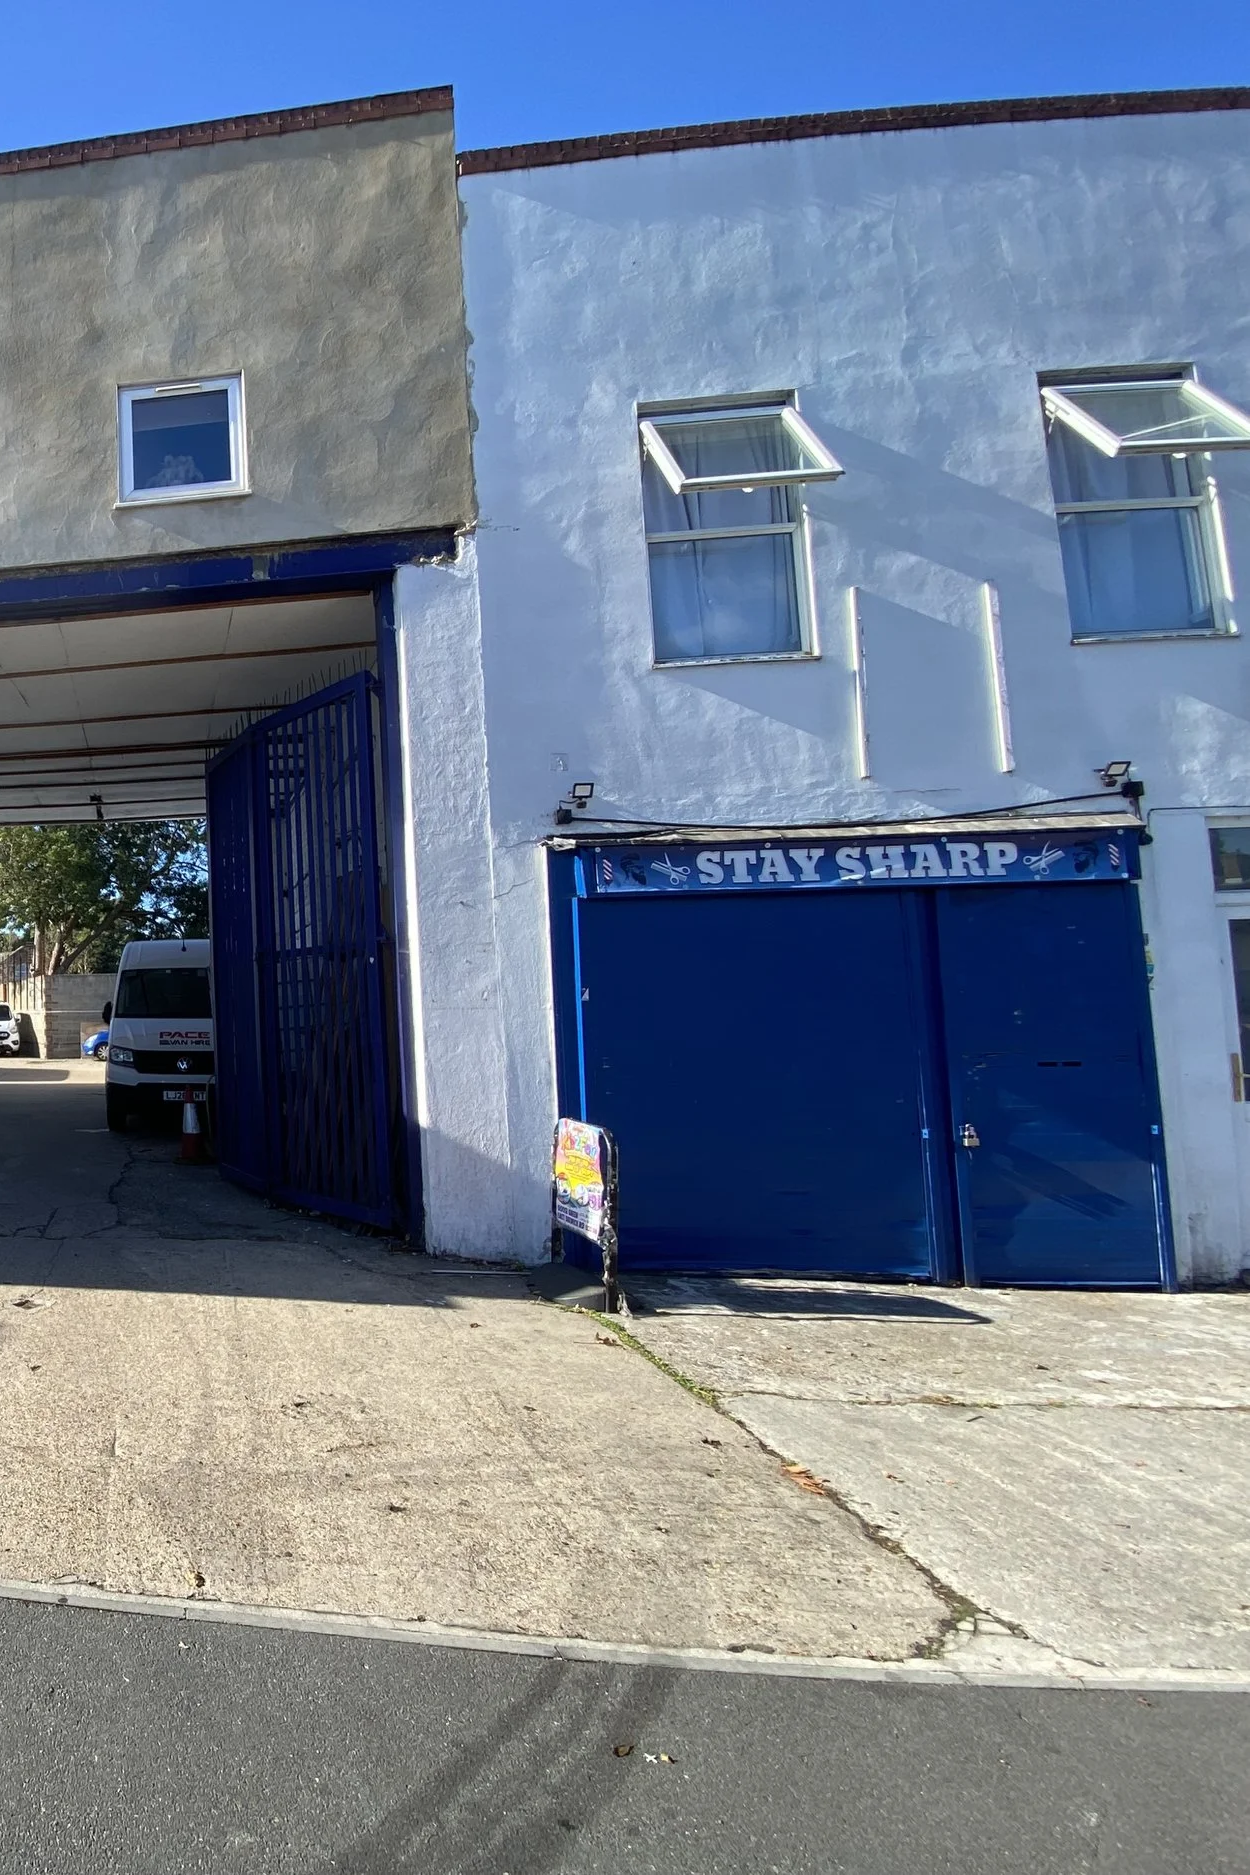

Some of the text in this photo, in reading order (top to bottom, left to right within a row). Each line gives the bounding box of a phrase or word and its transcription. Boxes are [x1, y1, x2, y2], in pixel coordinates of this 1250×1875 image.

[695, 840, 1019, 885] STAY SHARP
[159, 1031, 210, 1039] PACE
